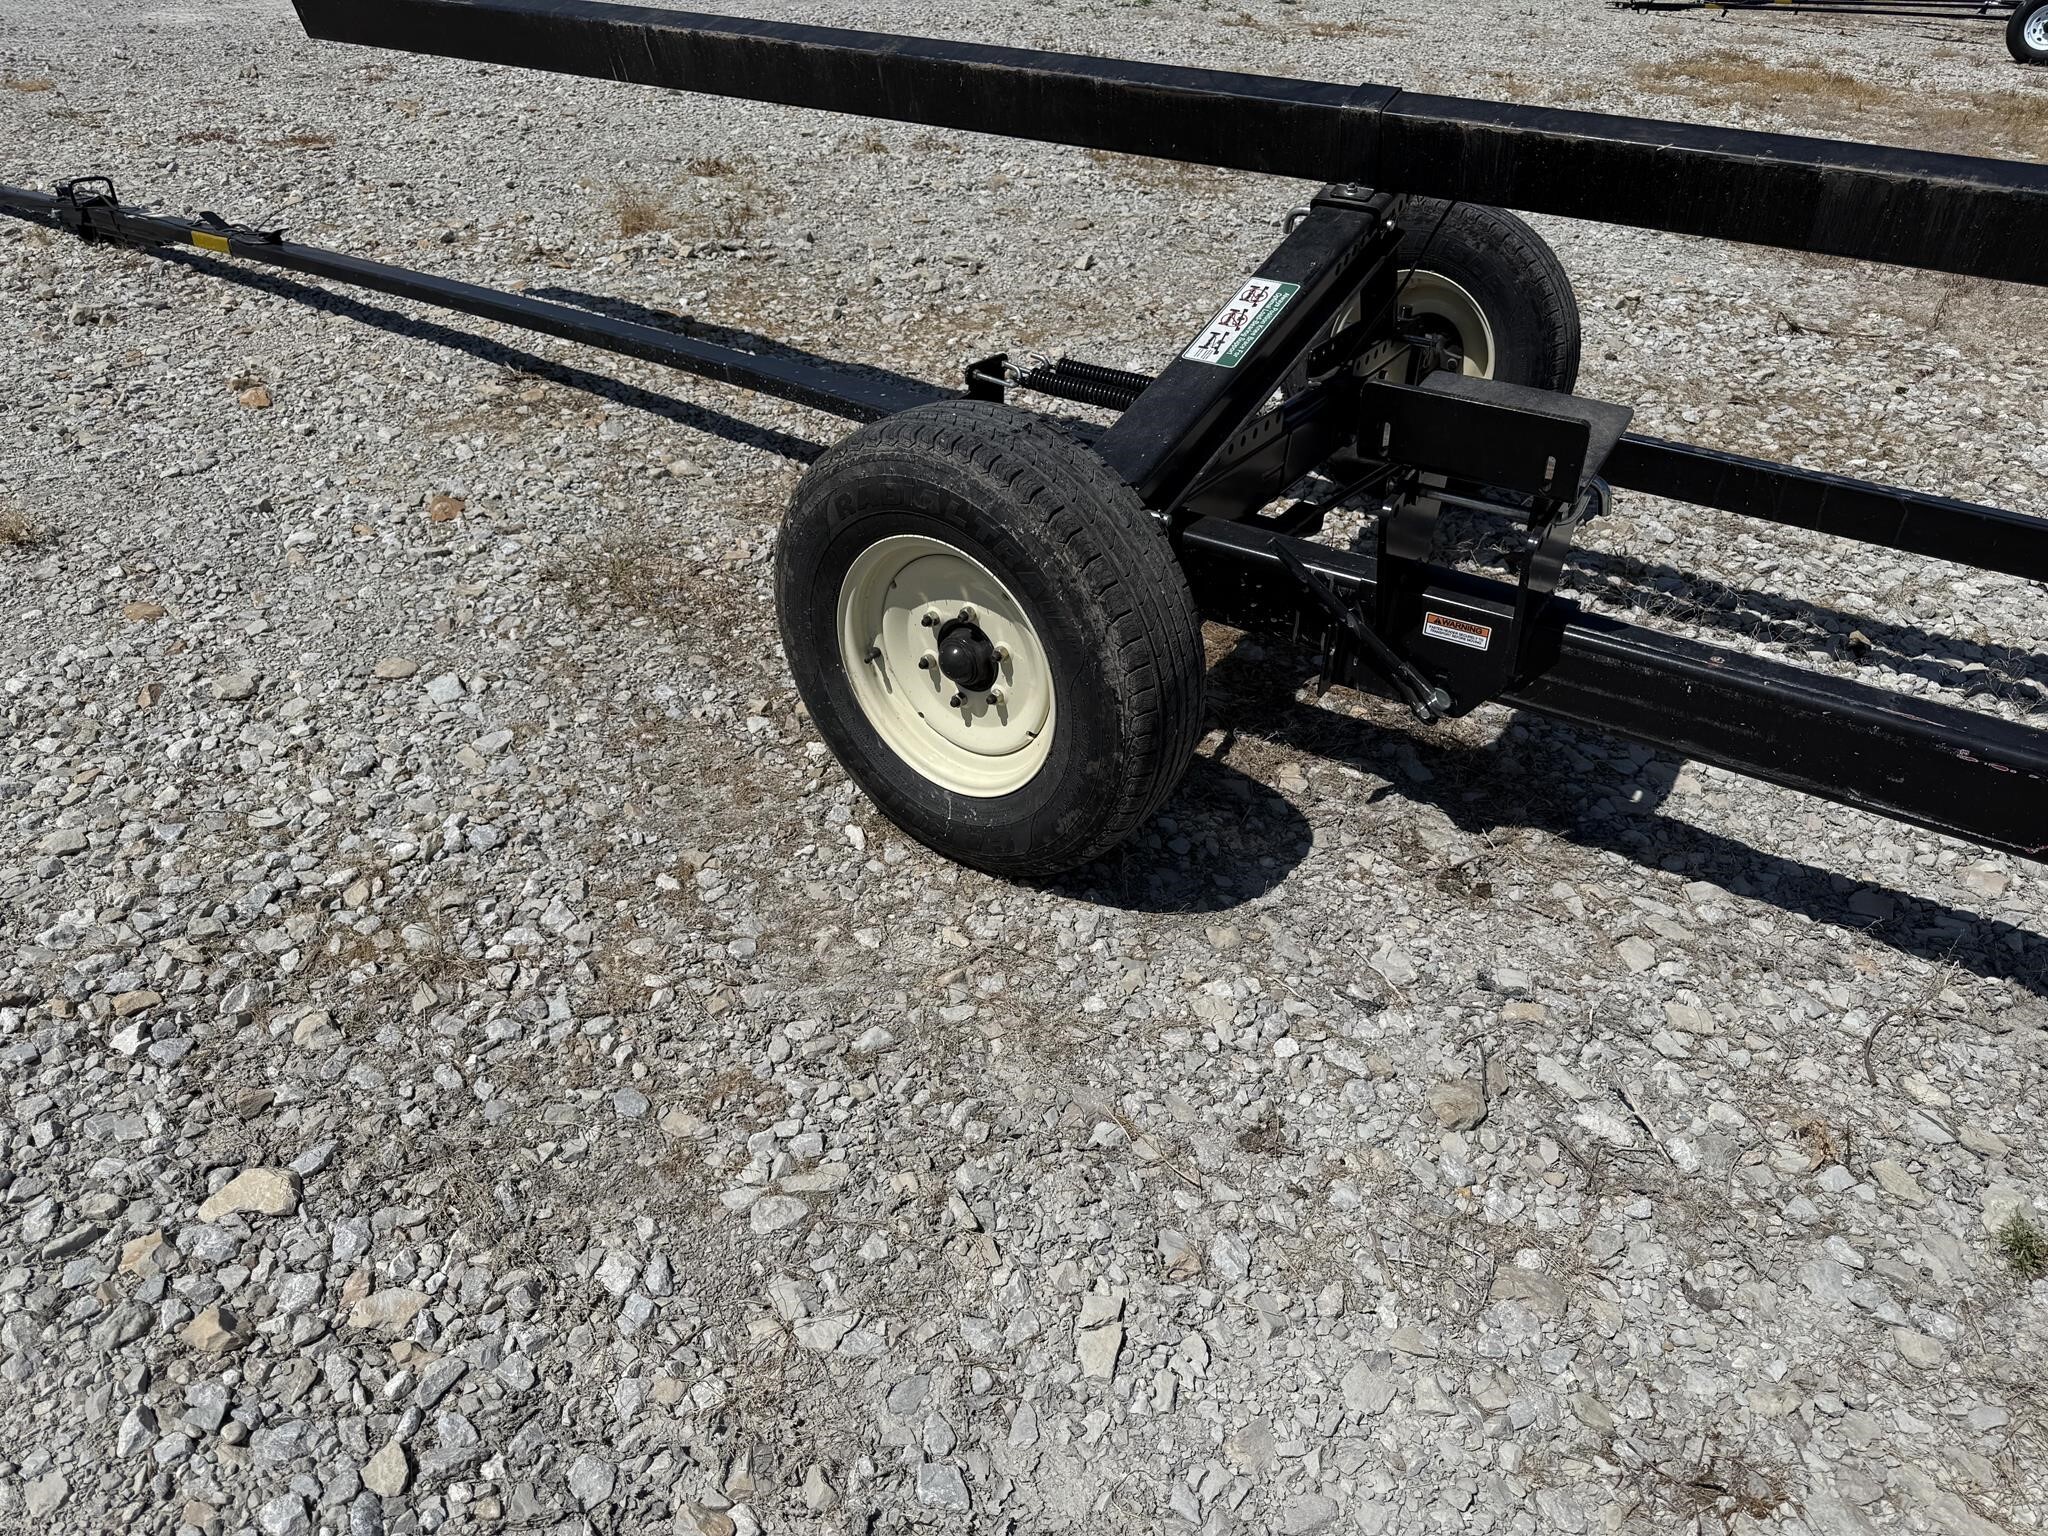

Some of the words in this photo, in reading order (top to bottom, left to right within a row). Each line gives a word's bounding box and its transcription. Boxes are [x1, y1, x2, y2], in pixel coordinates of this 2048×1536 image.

[1259, 307, 1278, 324] Position
[1250, 324, 1264, 335] Knee
[1442, 618, 1482, 634] WARNING
